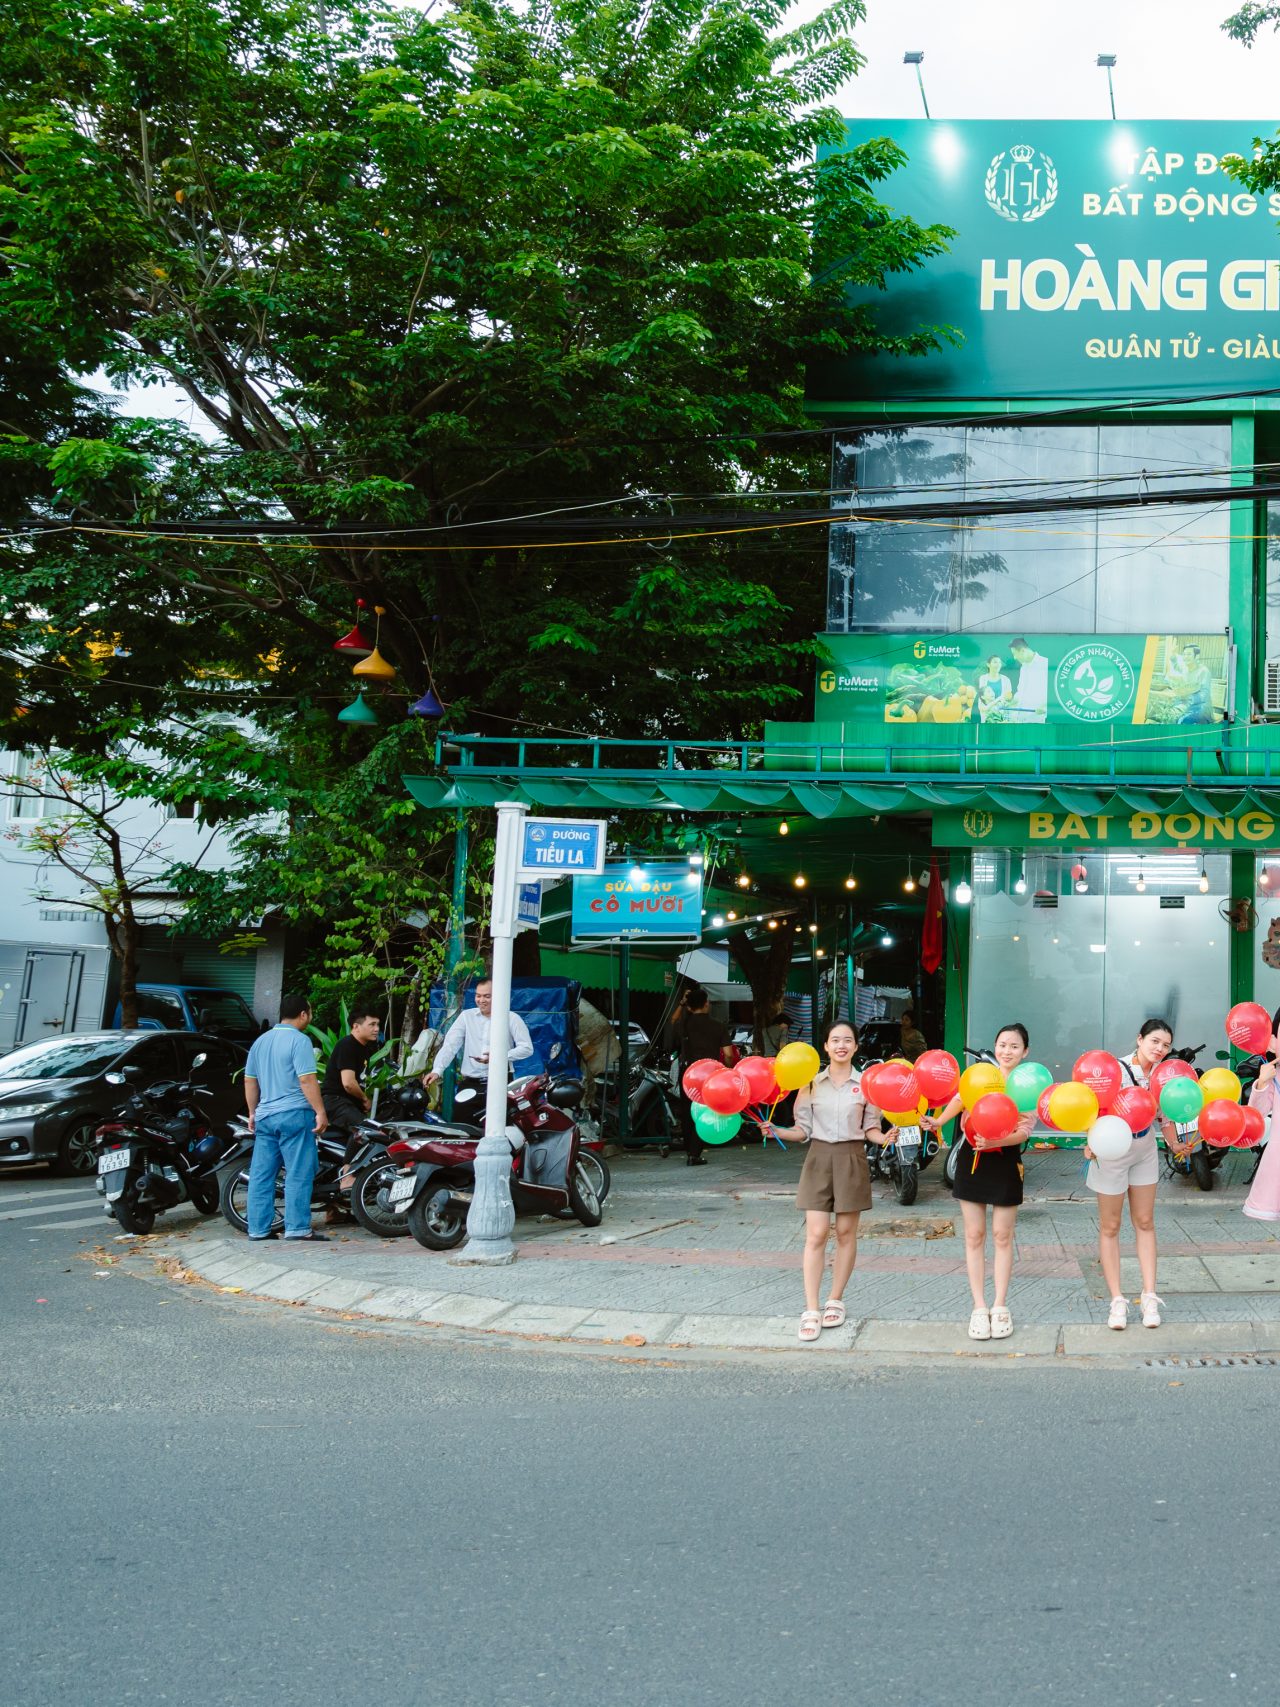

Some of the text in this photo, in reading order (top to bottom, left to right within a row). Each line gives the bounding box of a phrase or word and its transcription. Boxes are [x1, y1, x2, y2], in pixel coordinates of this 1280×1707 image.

[1083, 183, 1144, 216] BẤT
[1154, 187, 1258, 223] ĐỘNG
[980, 243, 1208, 312] HOÀNG
[1085, 333, 1162, 359] QUÂN
[1169, 331, 1202, 359] TỬ
[928, 645, 961, 654] FuMart
[1113, 656, 1131, 681] XANH
[838, 676, 879, 687] FuMart
[1065, 699, 1124, 719] RAU AN TOÀN
[552, 828, 591, 841] ĐƯỜNG
[535, 841, 584, 865] TIỂU LA
[590, 894, 620, 913] CÔ
